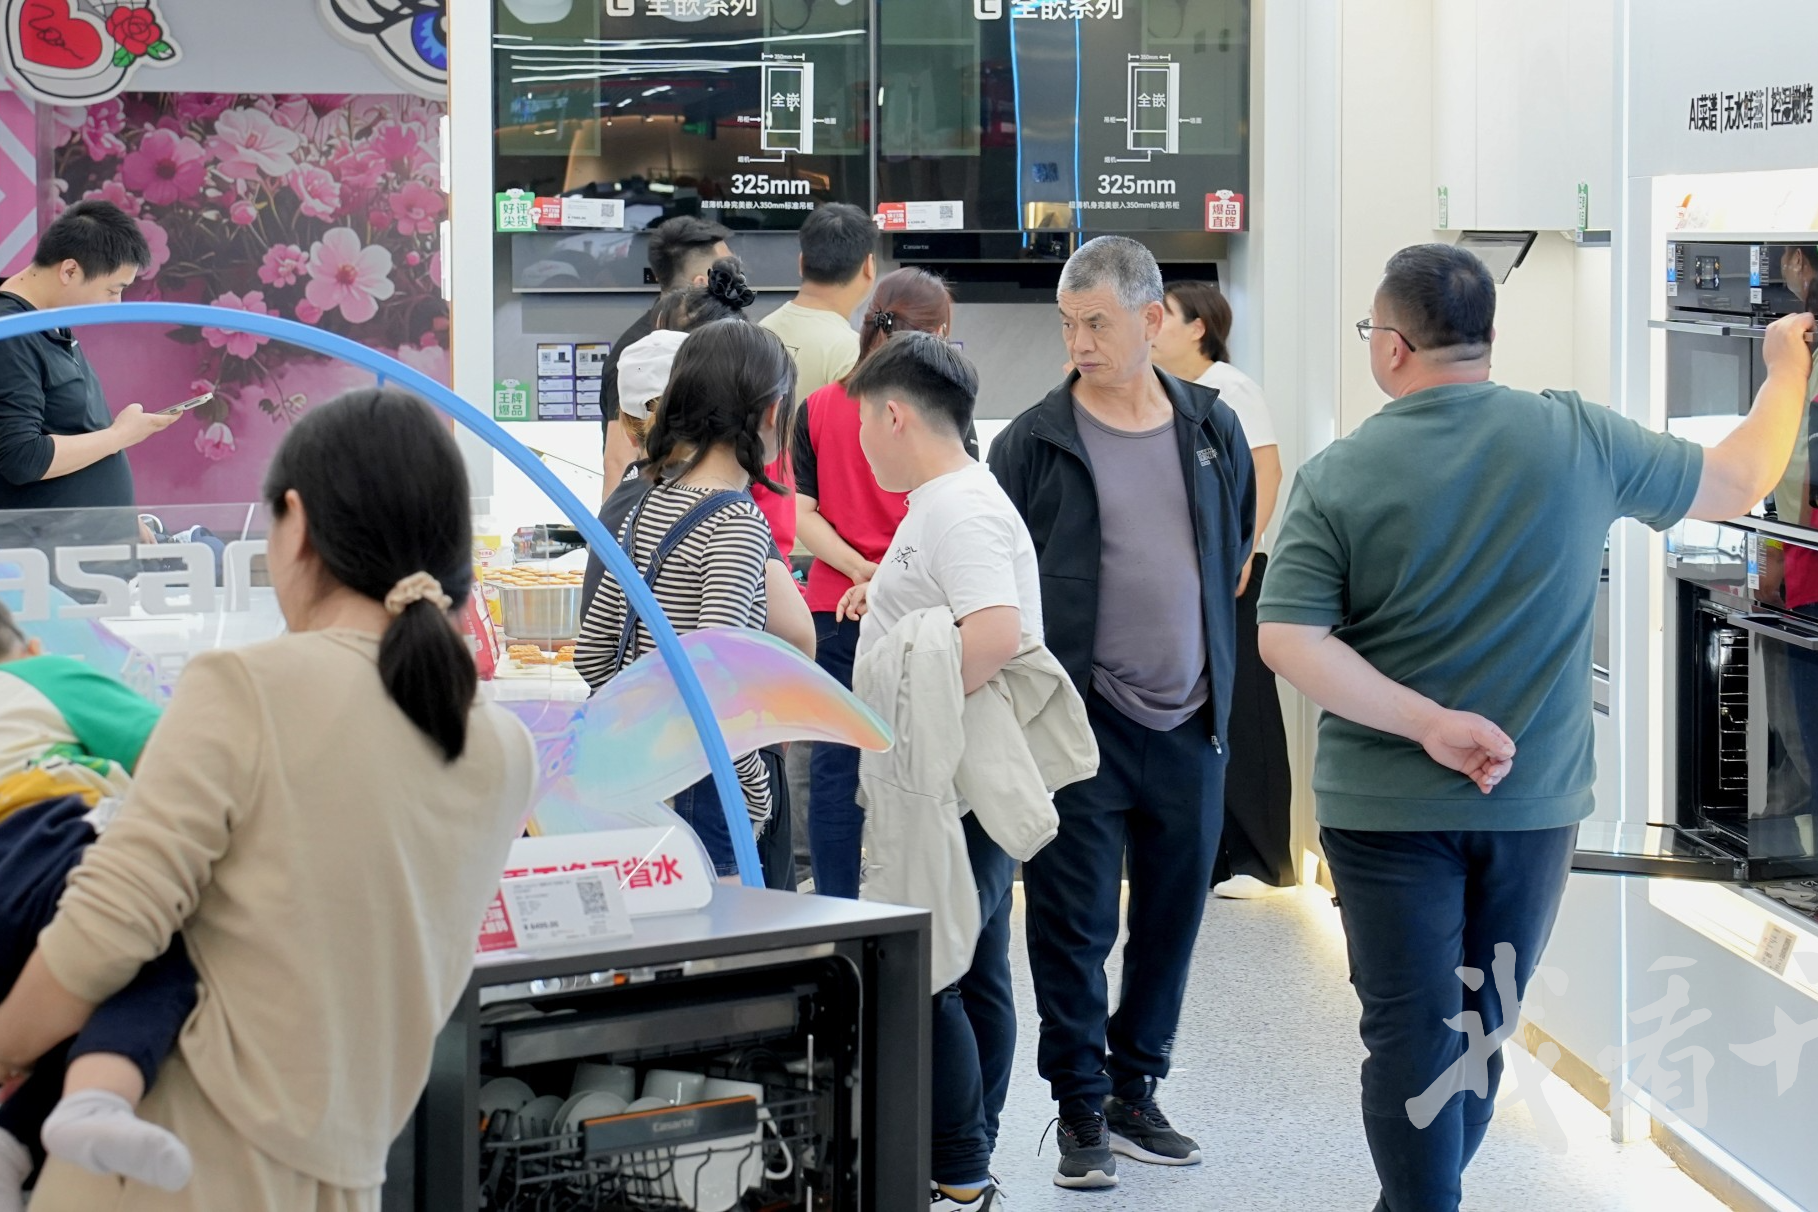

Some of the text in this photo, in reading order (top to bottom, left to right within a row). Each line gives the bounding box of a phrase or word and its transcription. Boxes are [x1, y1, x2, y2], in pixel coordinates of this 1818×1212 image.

[771, 92, 801, 108] 全嵌
[1137, 92, 1166, 108] 全嵌
[731, 174, 810, 195] 325mm
[1097, 174, 1176, 195] 325mm
[503, 203, 528, 214] 好评
[1212, 203, 1237, 216] 爆品
[503, 215, 528, 226] 尖货
[1212, 216, 1237, 228] 直降
[499, 392, 523, 403] 王牌
